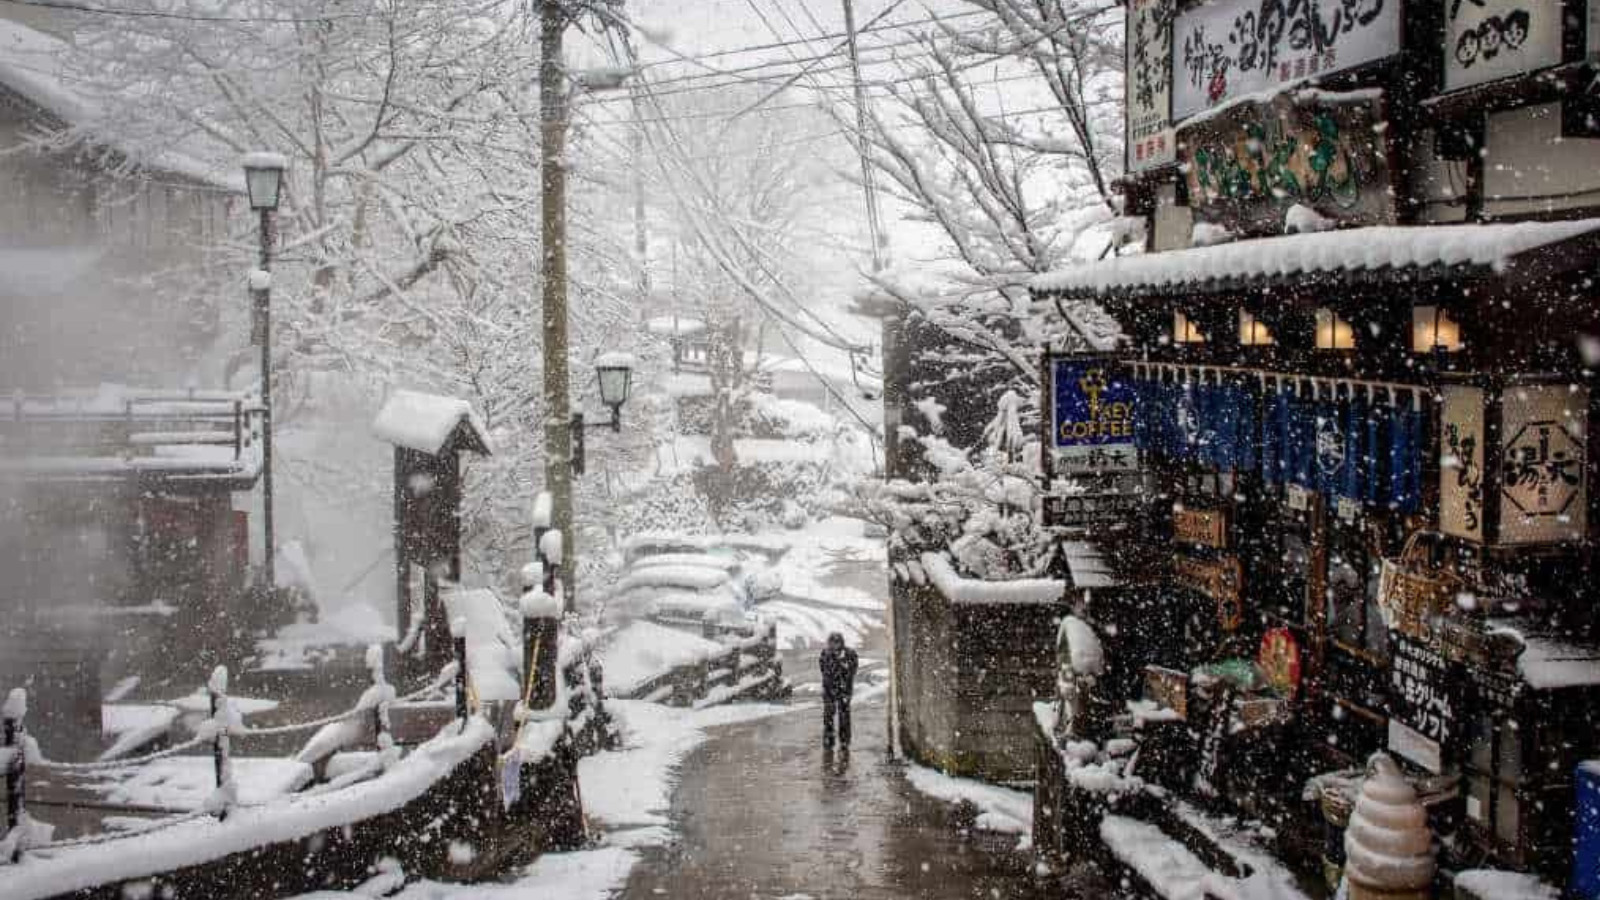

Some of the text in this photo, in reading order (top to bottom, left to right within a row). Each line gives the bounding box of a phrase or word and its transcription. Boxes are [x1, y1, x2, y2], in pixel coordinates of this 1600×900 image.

[1102, 402, 1134, 419] KEY
[1060, 421, 1133, 438] COFFEE
[1417, 707, 1451, 744] ソフト
